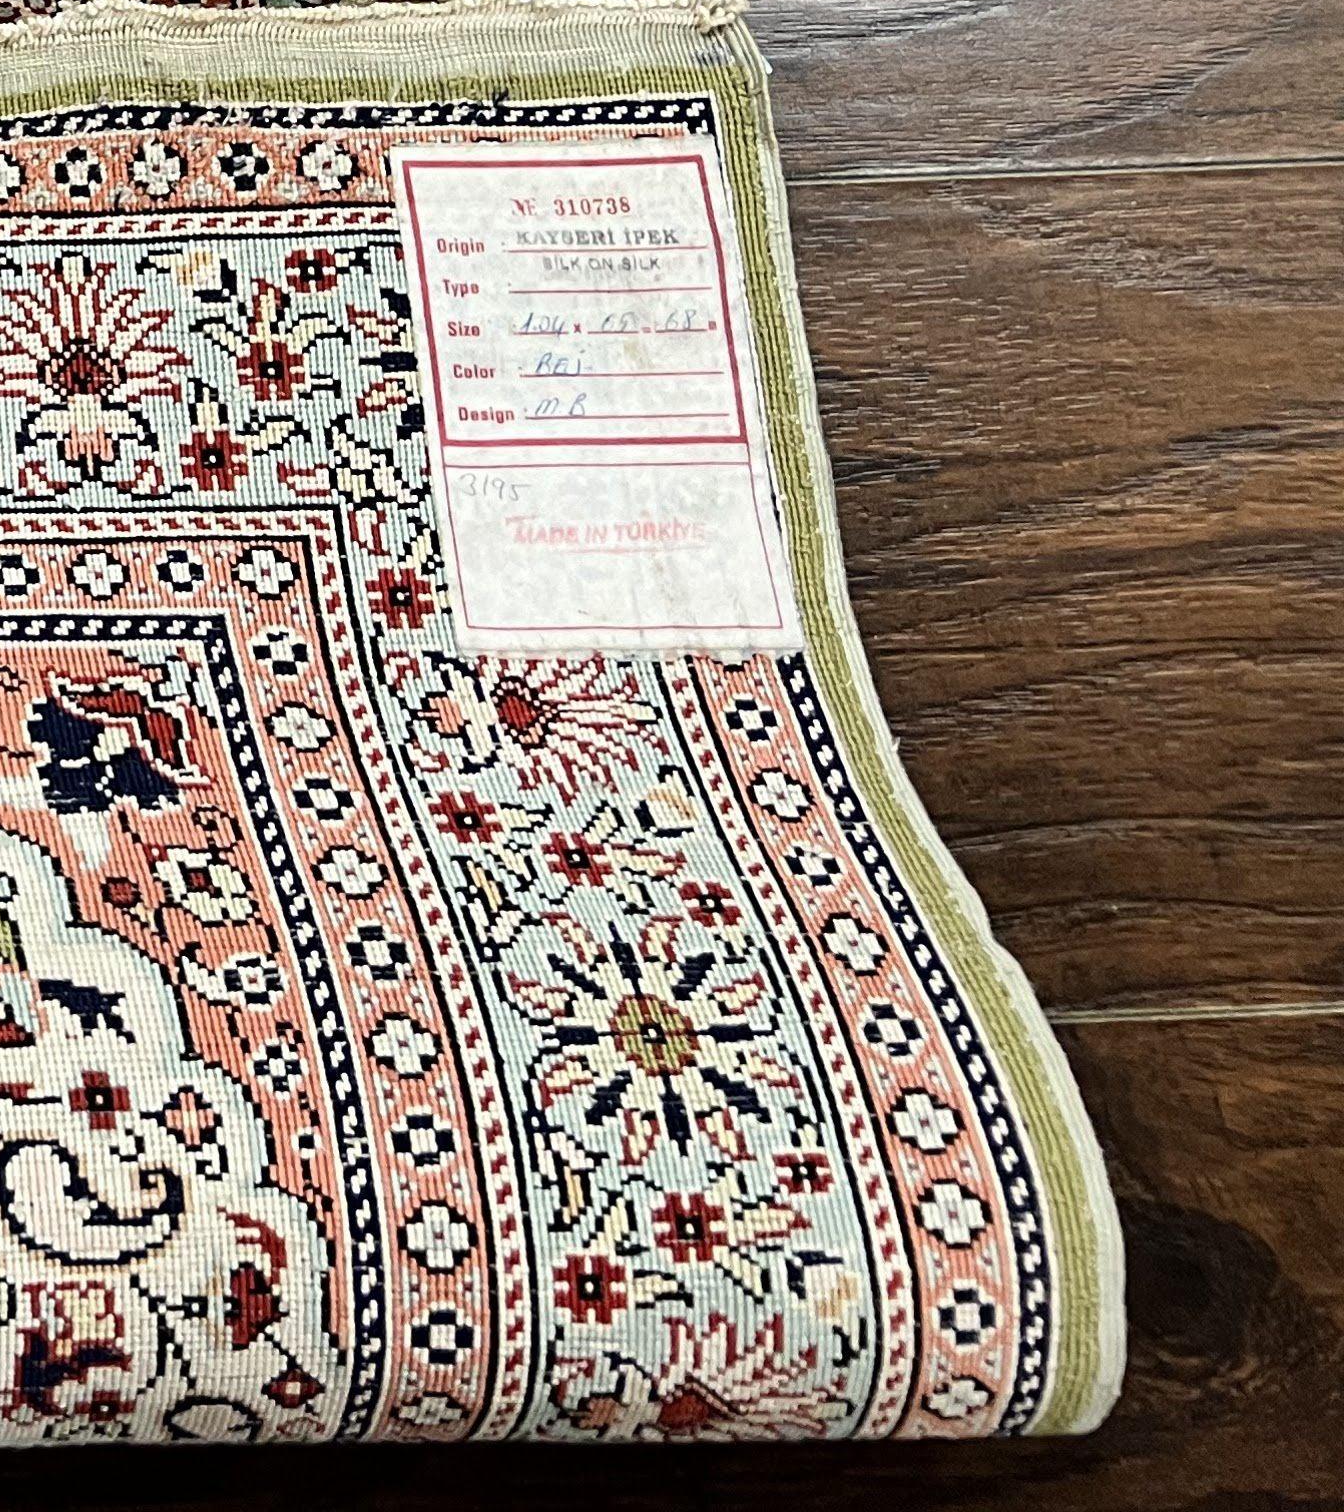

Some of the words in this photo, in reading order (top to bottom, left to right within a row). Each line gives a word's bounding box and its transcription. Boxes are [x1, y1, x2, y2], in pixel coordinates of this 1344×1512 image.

[553, 196, 631, 217] 310738
[436, 238, 485, 256] Origin
[588, 257, 614, 272] ON
[442, 279, 480, 298] Type
[447, 321, 481, 337] Size
[452, 364, 496, 379] Color
[458, 407, 516, 424] Design
[460, 472, 531, 501] 3195
[513, 523, 580, 545] MADE
[585, 523, 608, 543] IN
